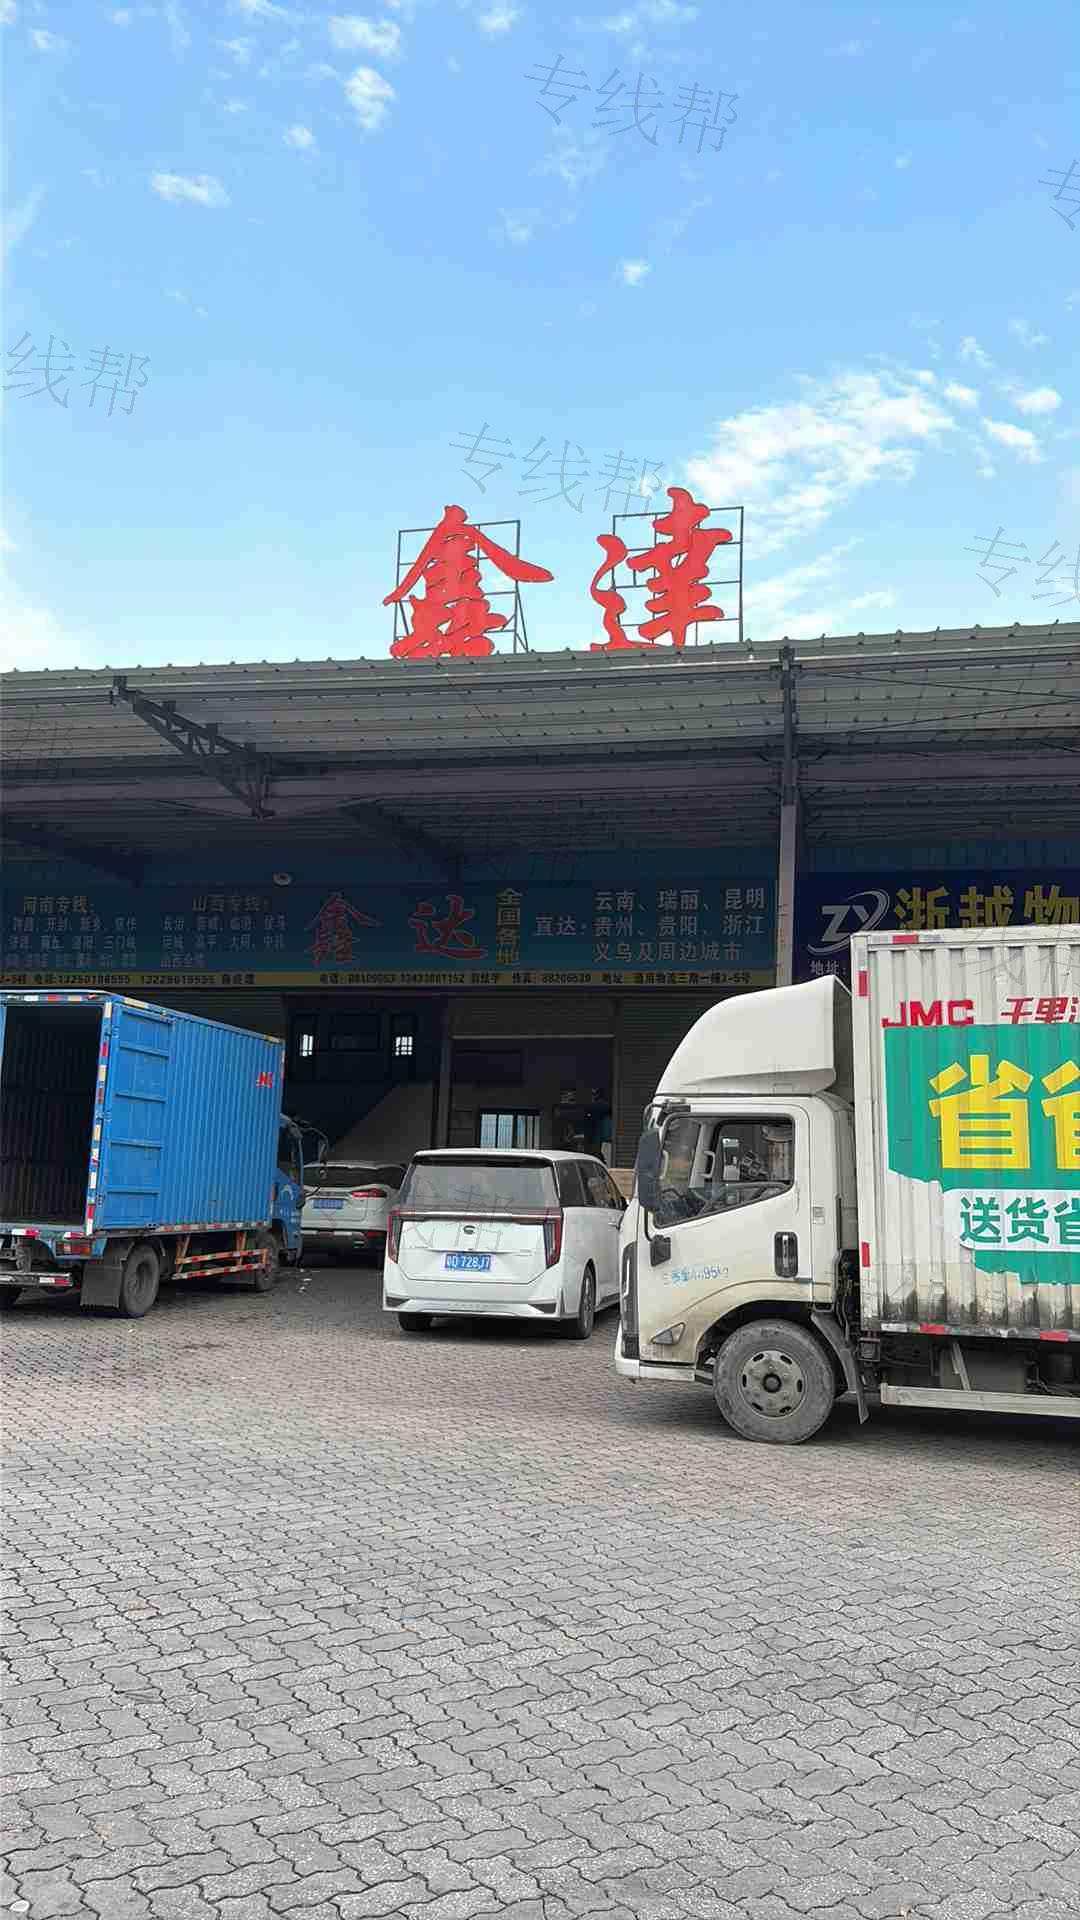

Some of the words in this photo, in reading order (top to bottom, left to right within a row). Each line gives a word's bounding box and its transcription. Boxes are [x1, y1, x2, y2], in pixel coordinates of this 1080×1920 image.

[496, 887, 522, 966] 全国各地
[594, 940, 744, 963] 义乌及周边城市
[881, 1000, 975, 1028] JMC
